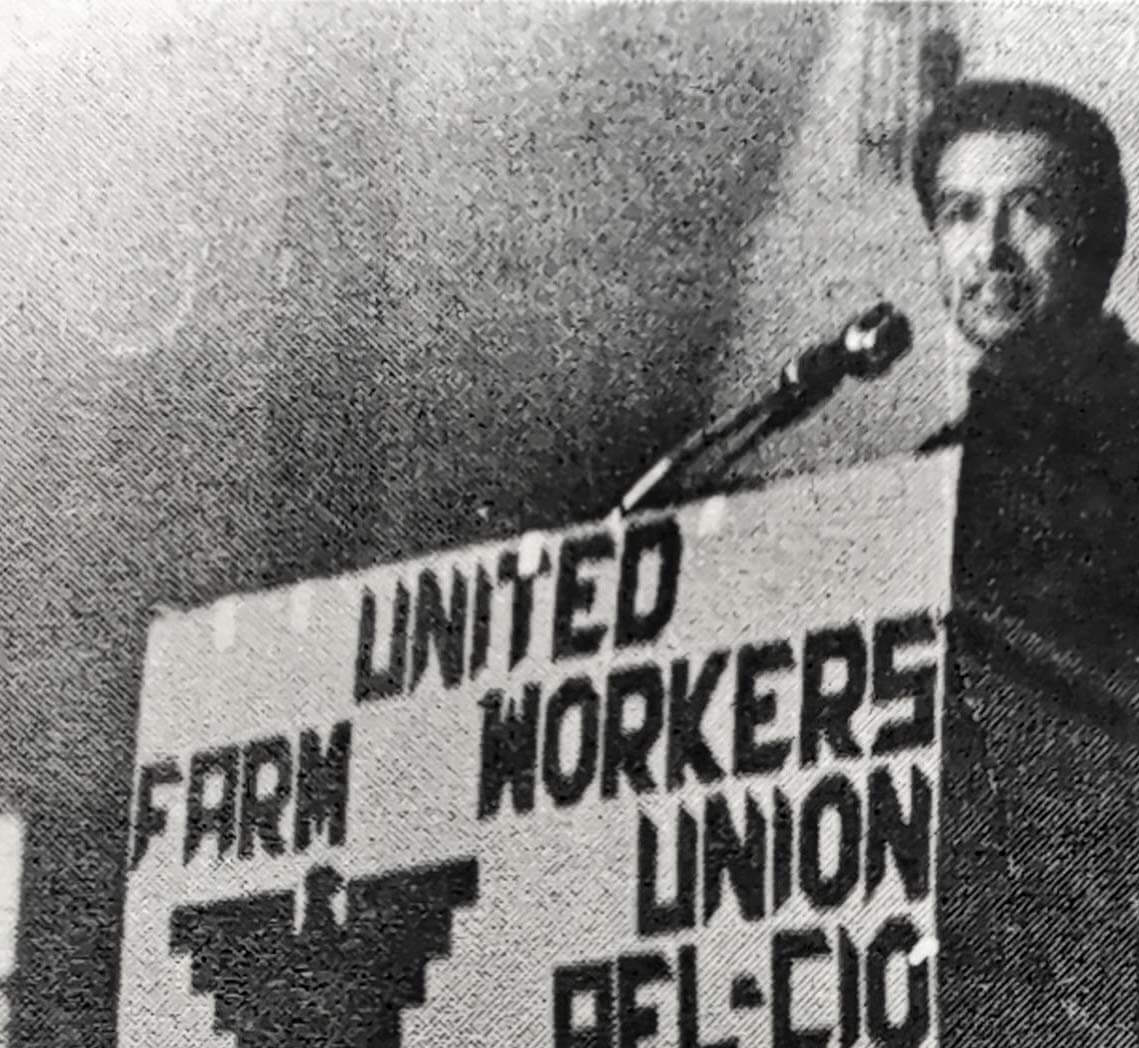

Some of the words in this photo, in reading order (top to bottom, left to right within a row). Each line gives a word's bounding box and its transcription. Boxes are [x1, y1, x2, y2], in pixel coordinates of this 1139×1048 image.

[353, 518, 683, 707] UNITED
[131, 720, 352, 871] FARM
[477, 613, 939, 820] WORKERS
[638, 764, 934, 938] UNION
